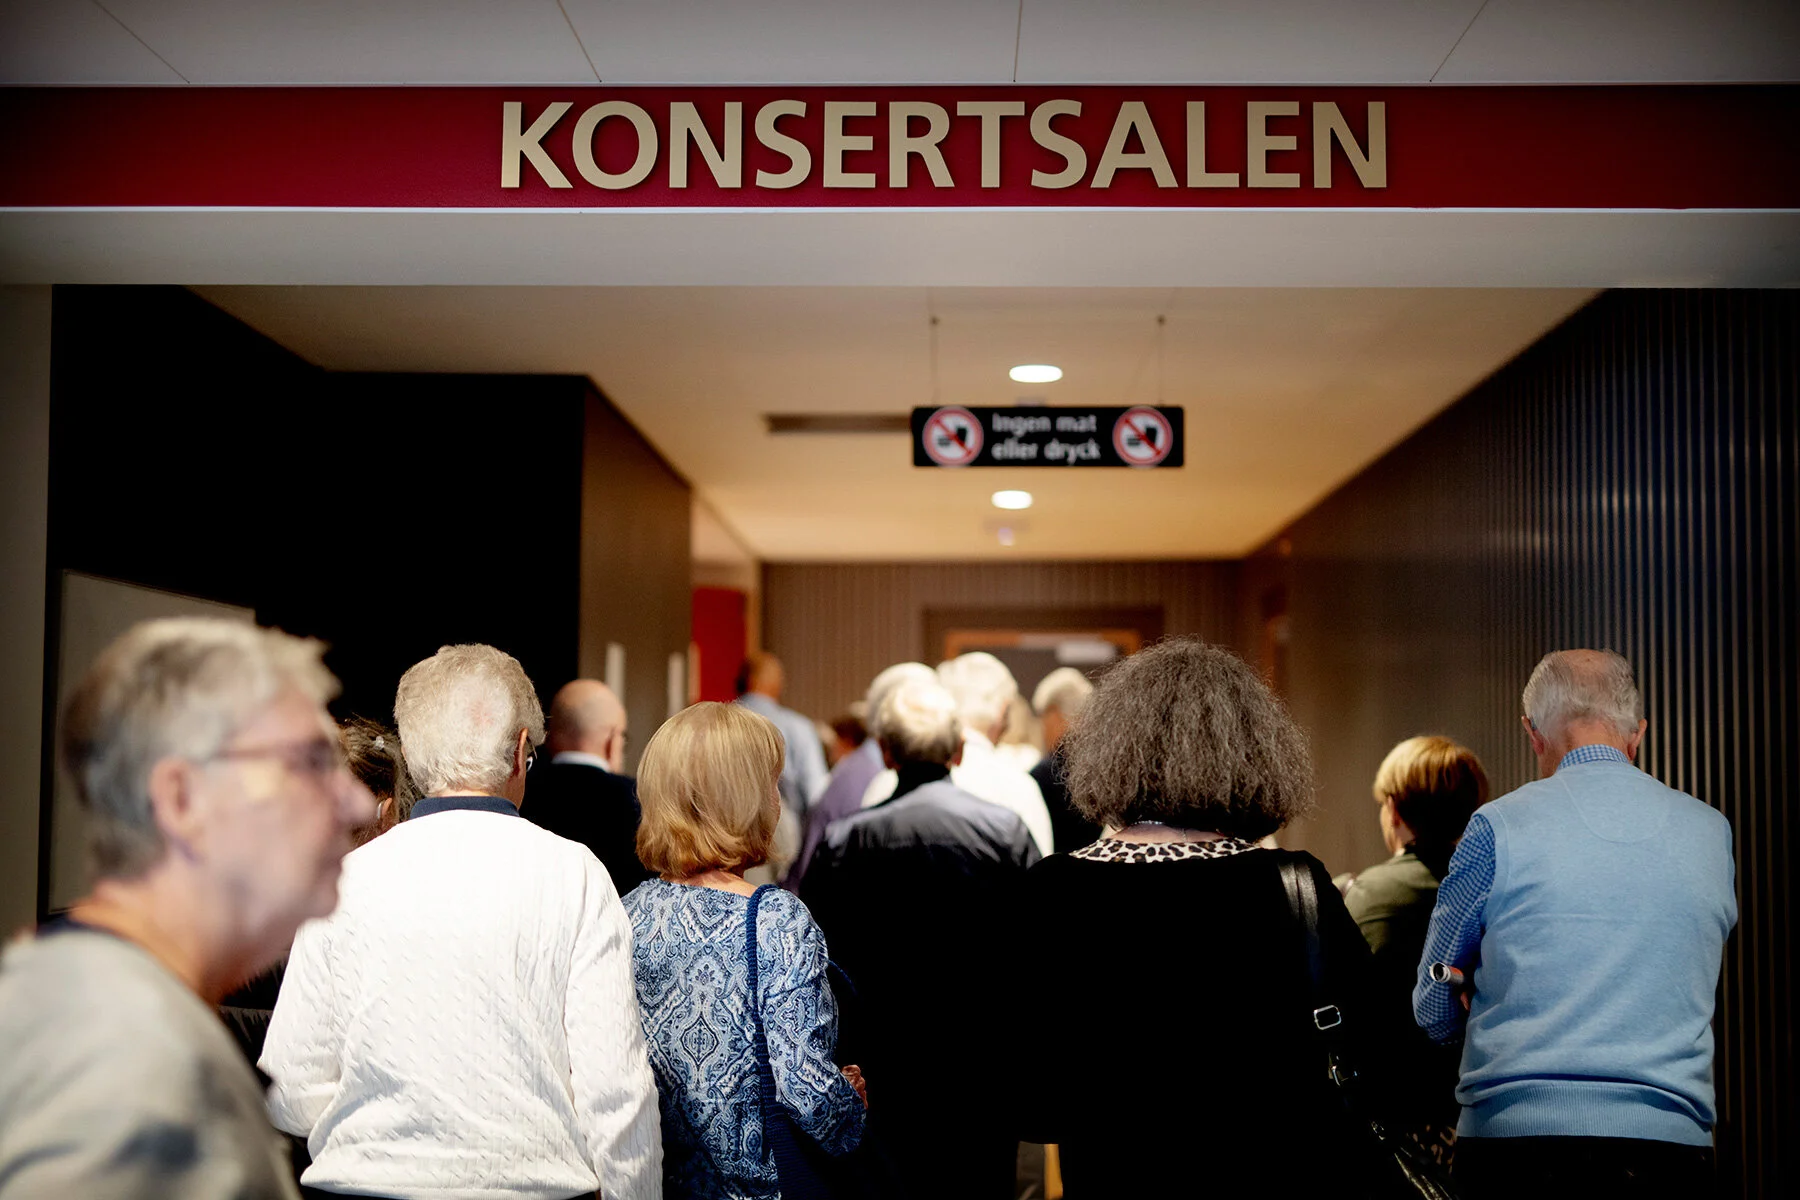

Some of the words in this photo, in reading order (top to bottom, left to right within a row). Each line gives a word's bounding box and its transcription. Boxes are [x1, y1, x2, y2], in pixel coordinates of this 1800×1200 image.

[500, 100, 1388, 189] KONSERTSALEN
[992, 413, 1050, 437] Ingen
[1056, 415, 1097, 432] mat
[991, 437, 1038, 460] eller
[1044, 437, 1100, 464] dryck
